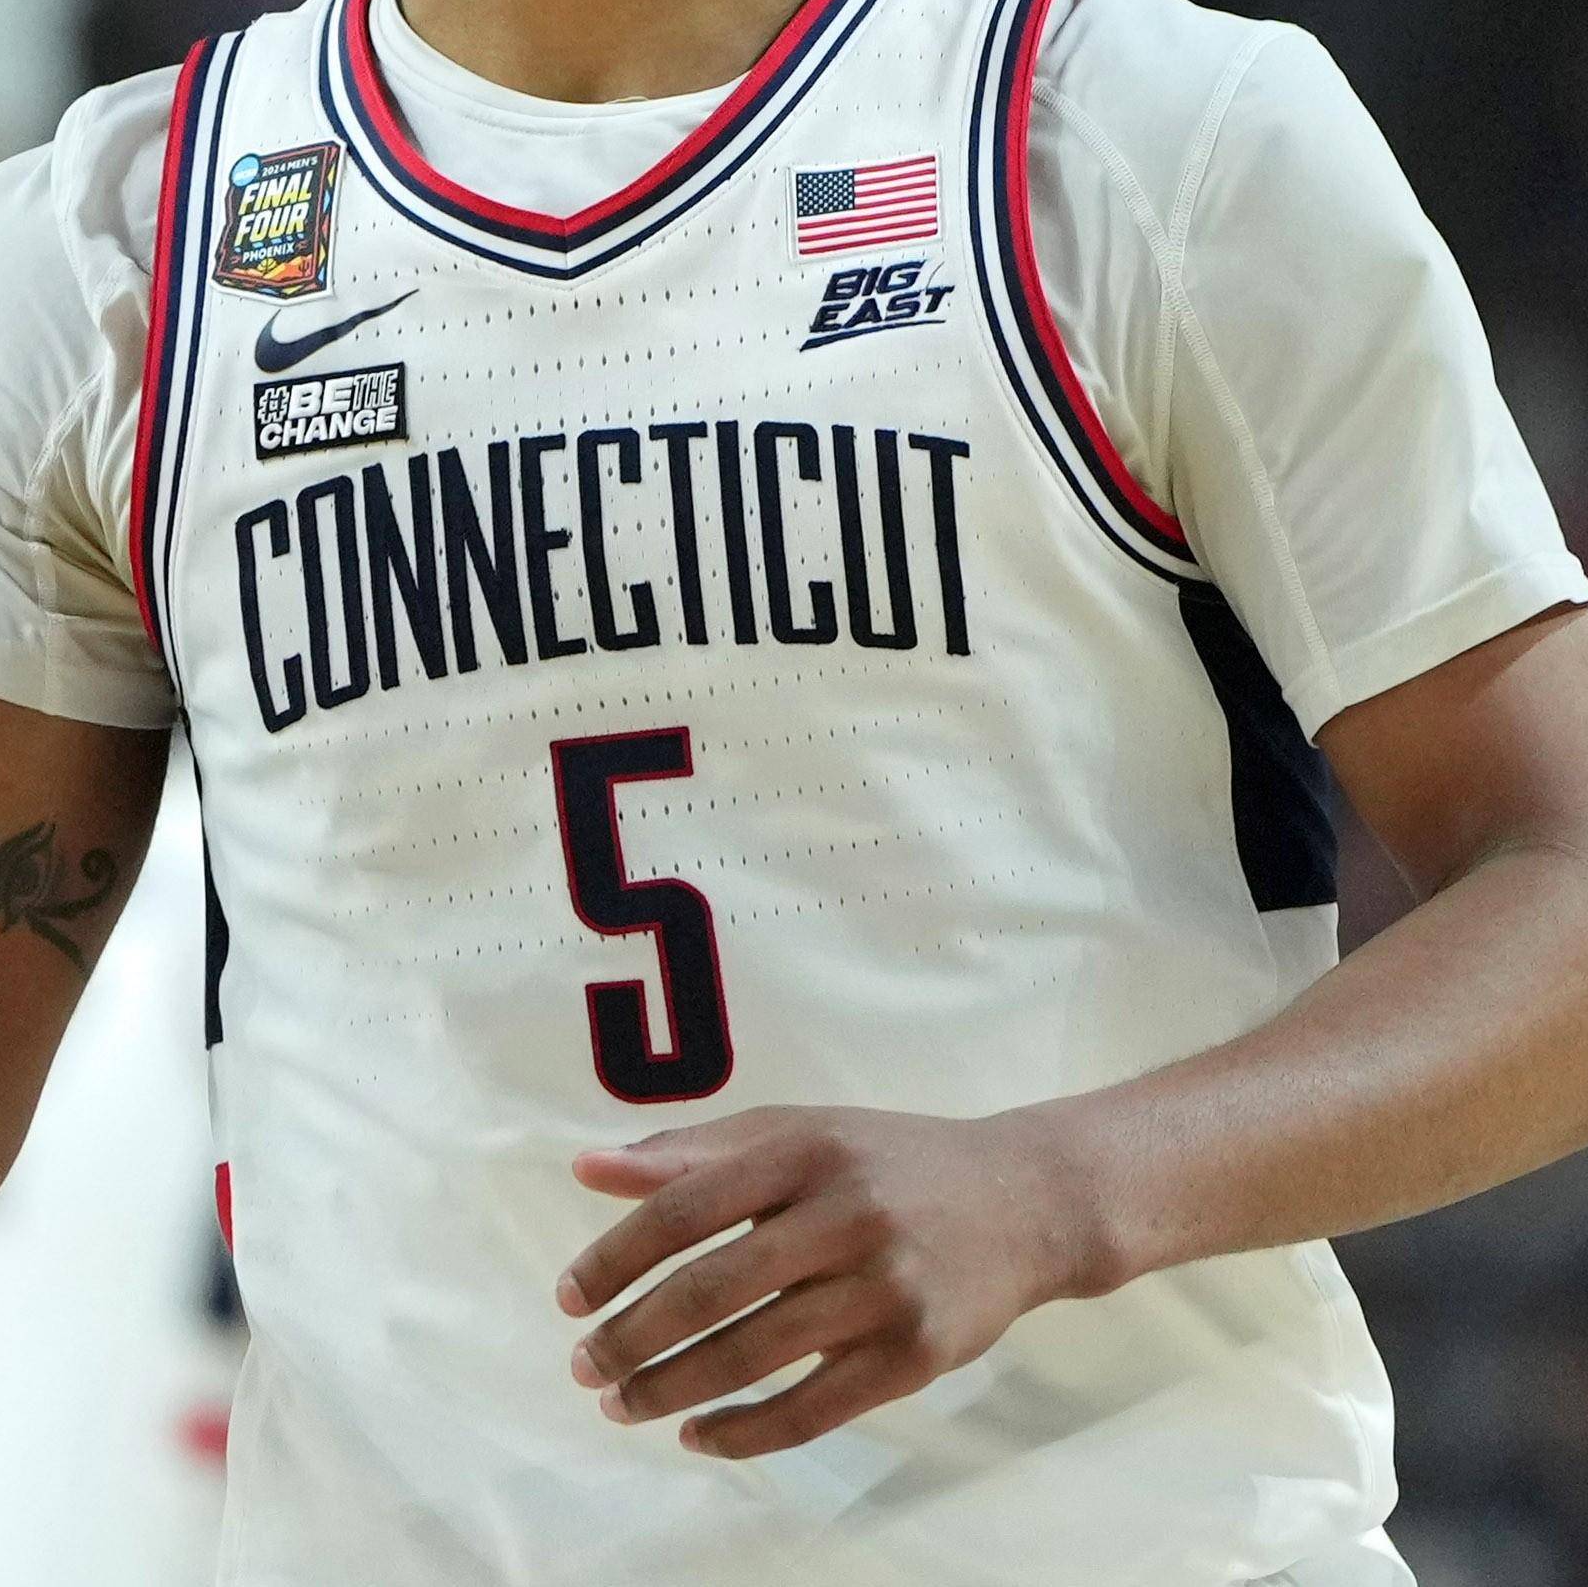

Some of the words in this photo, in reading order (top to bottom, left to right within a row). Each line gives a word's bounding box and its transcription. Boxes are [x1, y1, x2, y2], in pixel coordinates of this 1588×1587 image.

[262, 162, 287, 177] 2024
[287, 155, 319, 172] MEN'S
[238, 169, 315, 215] FINAL
[234, 201, 310, 247] FOUR
[242, 241, 296, 263] PHOENIX
[821, 258, 928, 302] BIG
[809, 284, 956, 333] EAST
[259, 405, 399, 450] CHANGE
[234, 419, 972, 734] CONNECTICUT
[550, 725, 734, 1104] 5
